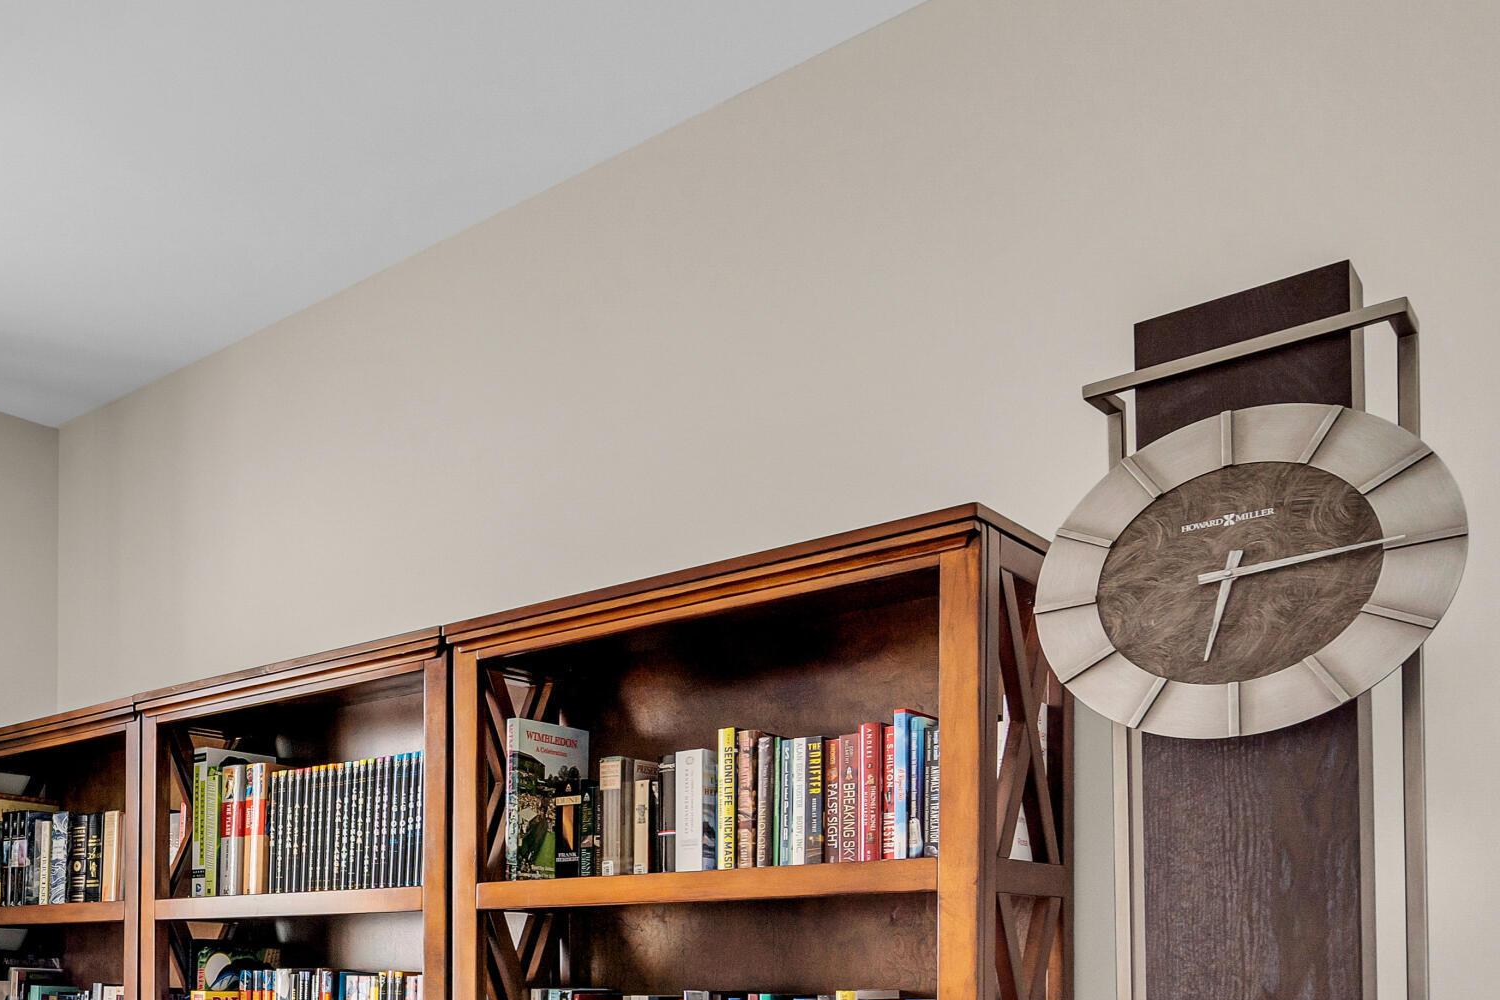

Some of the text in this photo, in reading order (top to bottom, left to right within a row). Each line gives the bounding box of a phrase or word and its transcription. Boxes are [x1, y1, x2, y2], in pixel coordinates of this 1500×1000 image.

[1181, 508, 1275, 532] HOWARD MILLER
[526, 731, 578, 749] WIMBLEDON
[809, 751, 821, 794] DRIFTER
[885, 754, 895, 788] HILTON
[929, 765, 939, 792] ANIMALS
[723, 747, 733, 868] SECOND LIFE NICK MASO
[827, 783, 838, 848] FALSE SIGHT
[843, 783, 856, 861] BREAKING SKY
[929, 803, 939, 843] TRANSLATION
[884, 812, 894, 854] MAESTRA
